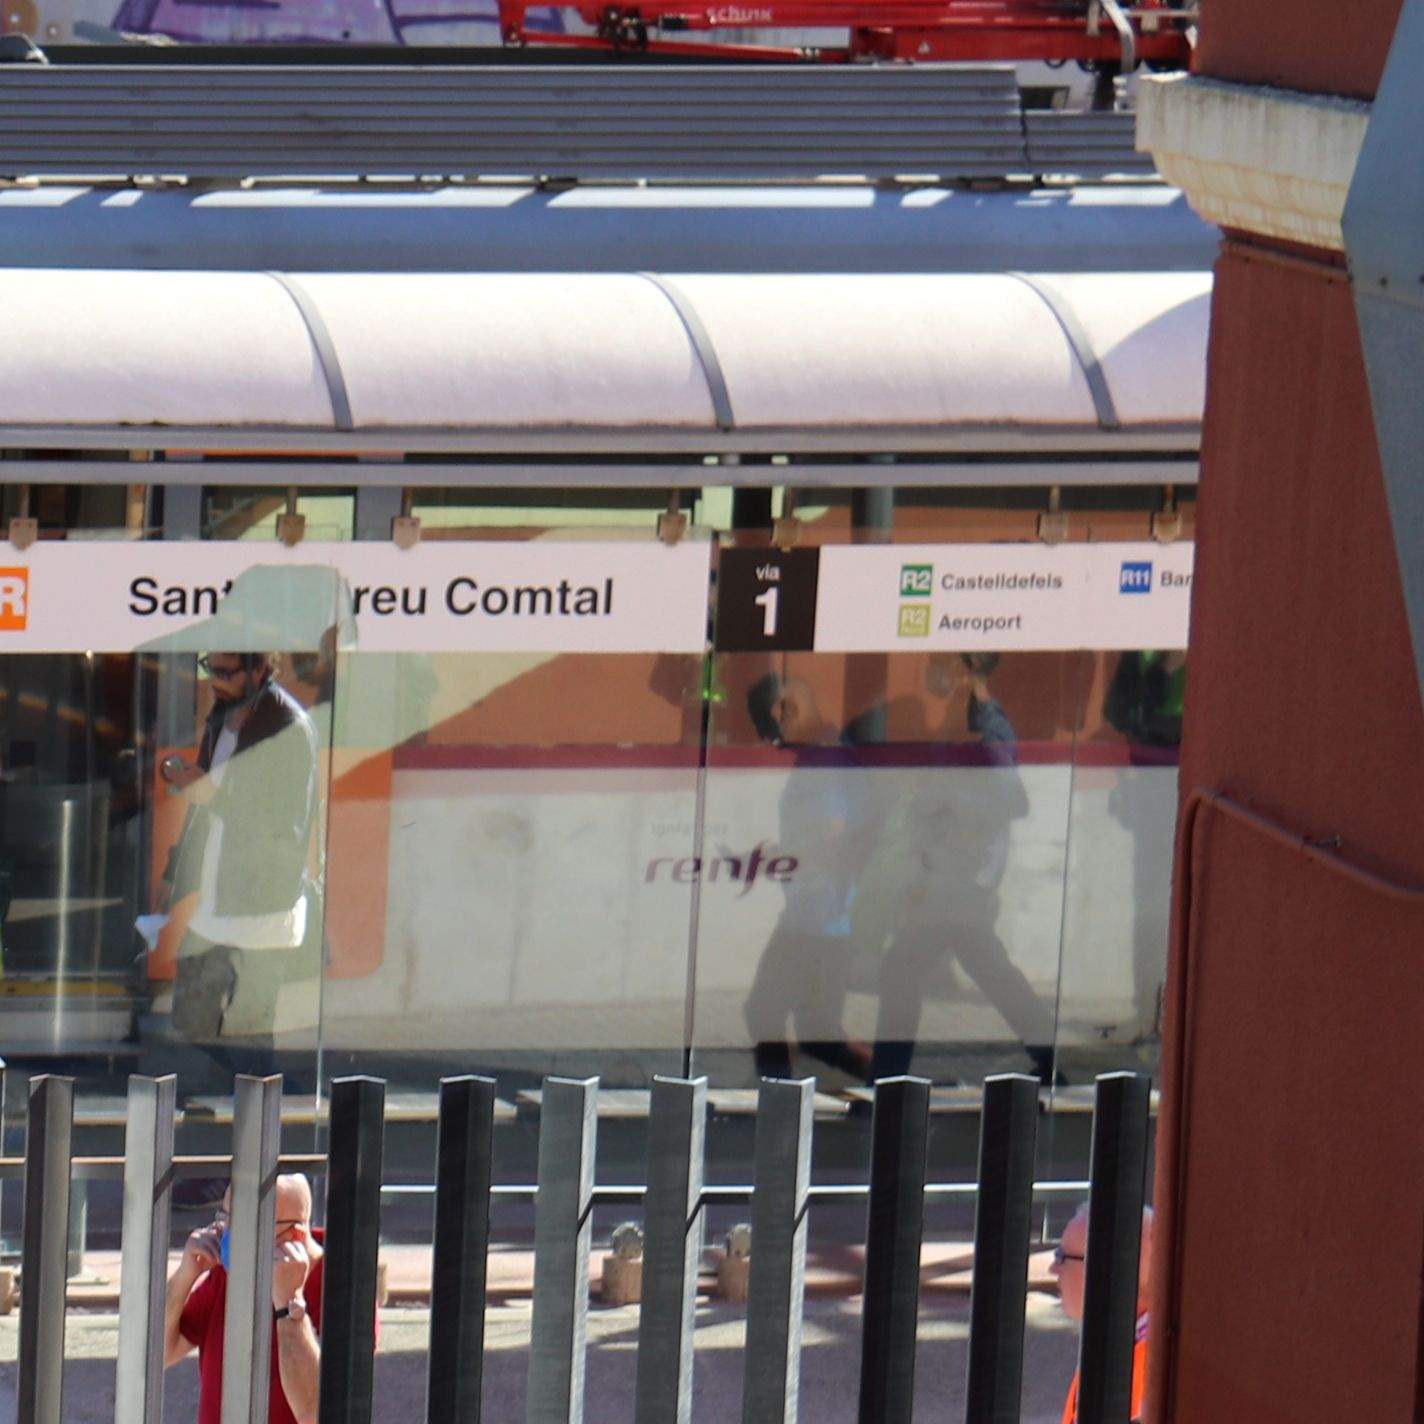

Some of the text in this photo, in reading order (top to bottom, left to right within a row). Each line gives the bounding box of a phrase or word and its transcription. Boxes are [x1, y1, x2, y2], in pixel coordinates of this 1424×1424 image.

[443, 576, 614, 617] Comtal
[940, 572, 1063, 591] Castelldefels
[754, 586, 779, 637] 1
[938, 613, 1022, 632] Aeroport
[644, 837, 800, 899] renfe
